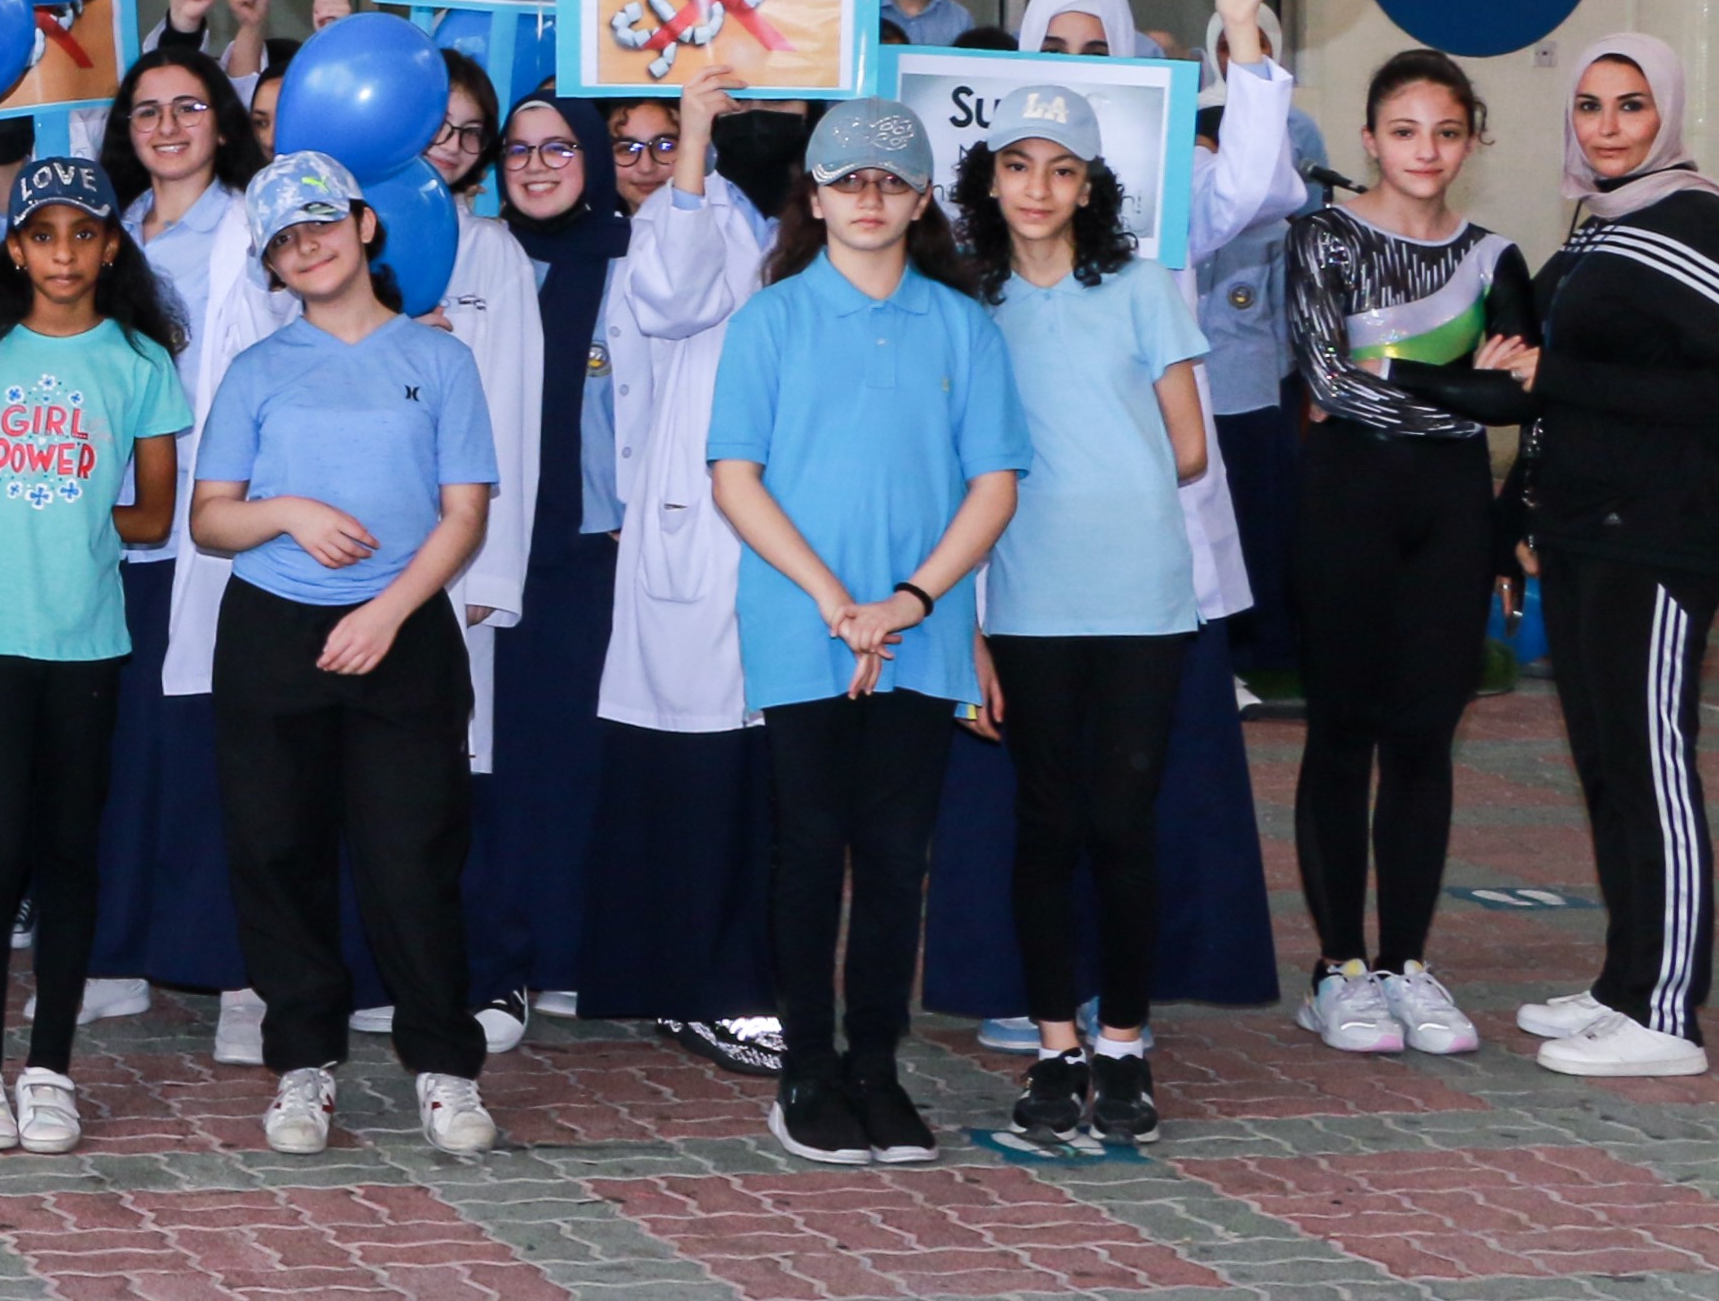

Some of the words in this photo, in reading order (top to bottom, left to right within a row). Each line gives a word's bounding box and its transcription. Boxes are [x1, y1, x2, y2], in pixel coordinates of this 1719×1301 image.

[1023, 92, 1070, 124] LA
[20, 162, 97, 202] LOVE
[1, 404, 89, 440] GIRL
